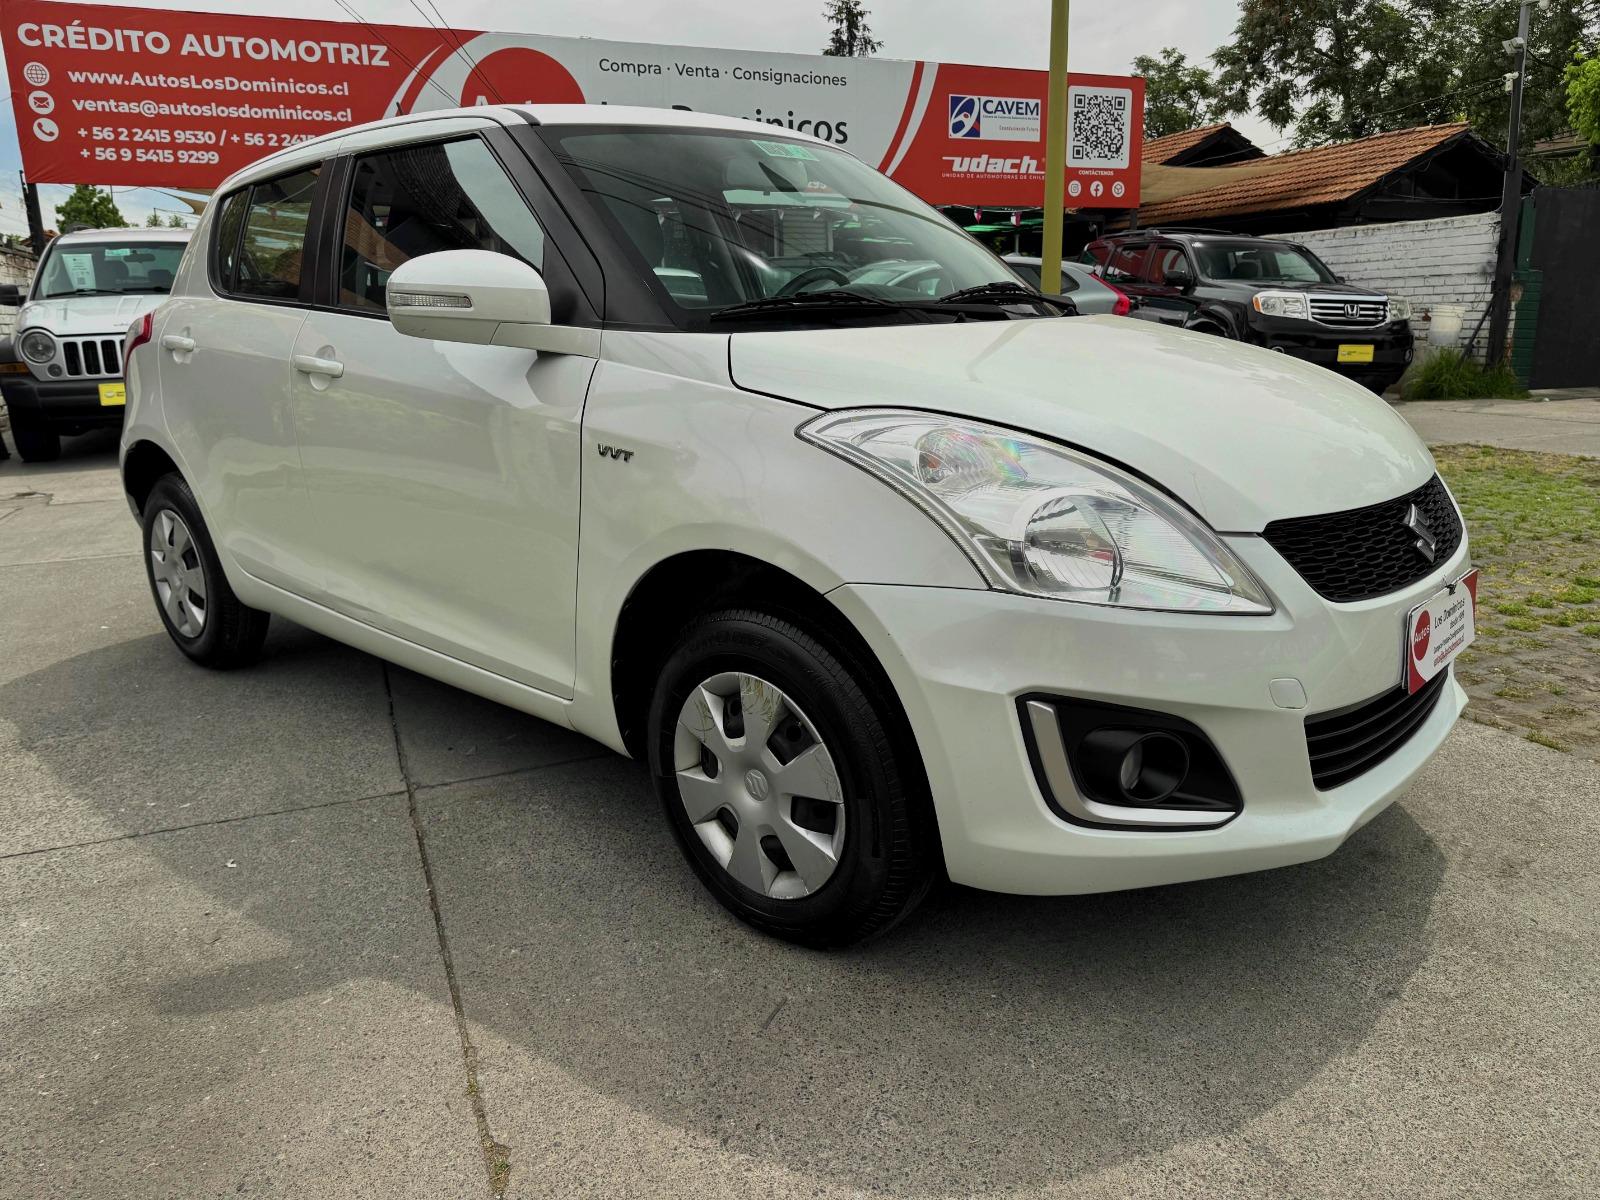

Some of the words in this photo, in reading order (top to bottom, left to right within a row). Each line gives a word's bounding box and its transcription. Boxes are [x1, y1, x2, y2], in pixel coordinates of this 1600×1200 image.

[17, 20, 171, 55] CRÉDITO
[180, 33, 390, 67] AUTOMOTRIZ
[599, 58, 662, 77] Compra
[674, 63, 720, 79] Venta
[732, 67, 847, 86] Consignaciones
[68, 70, 349, 96] www.AutosLosDominicos.cl
[72, 98, 352, 122] ventas@autoslosdominicos.cl
[982, 99, 1039, 116] CAVEM
[92, 126, 115, 141] 56
[118, 127, 129, 141] 2
[132, 128, 171, 143] 2415
[174, 129, 216, 145] 9530
[244, 132, 265, 146] 56
[267, 133, 279, 147] 2
[95, 147, 117, 161] 56
[120, 148, 132, 161] 9
[136, 148, 174, 163] 5415
[177, 149, 219, 165] 9299
[942, 154, 1045, 174] udach
[597, 443, 634, 463] VVT
